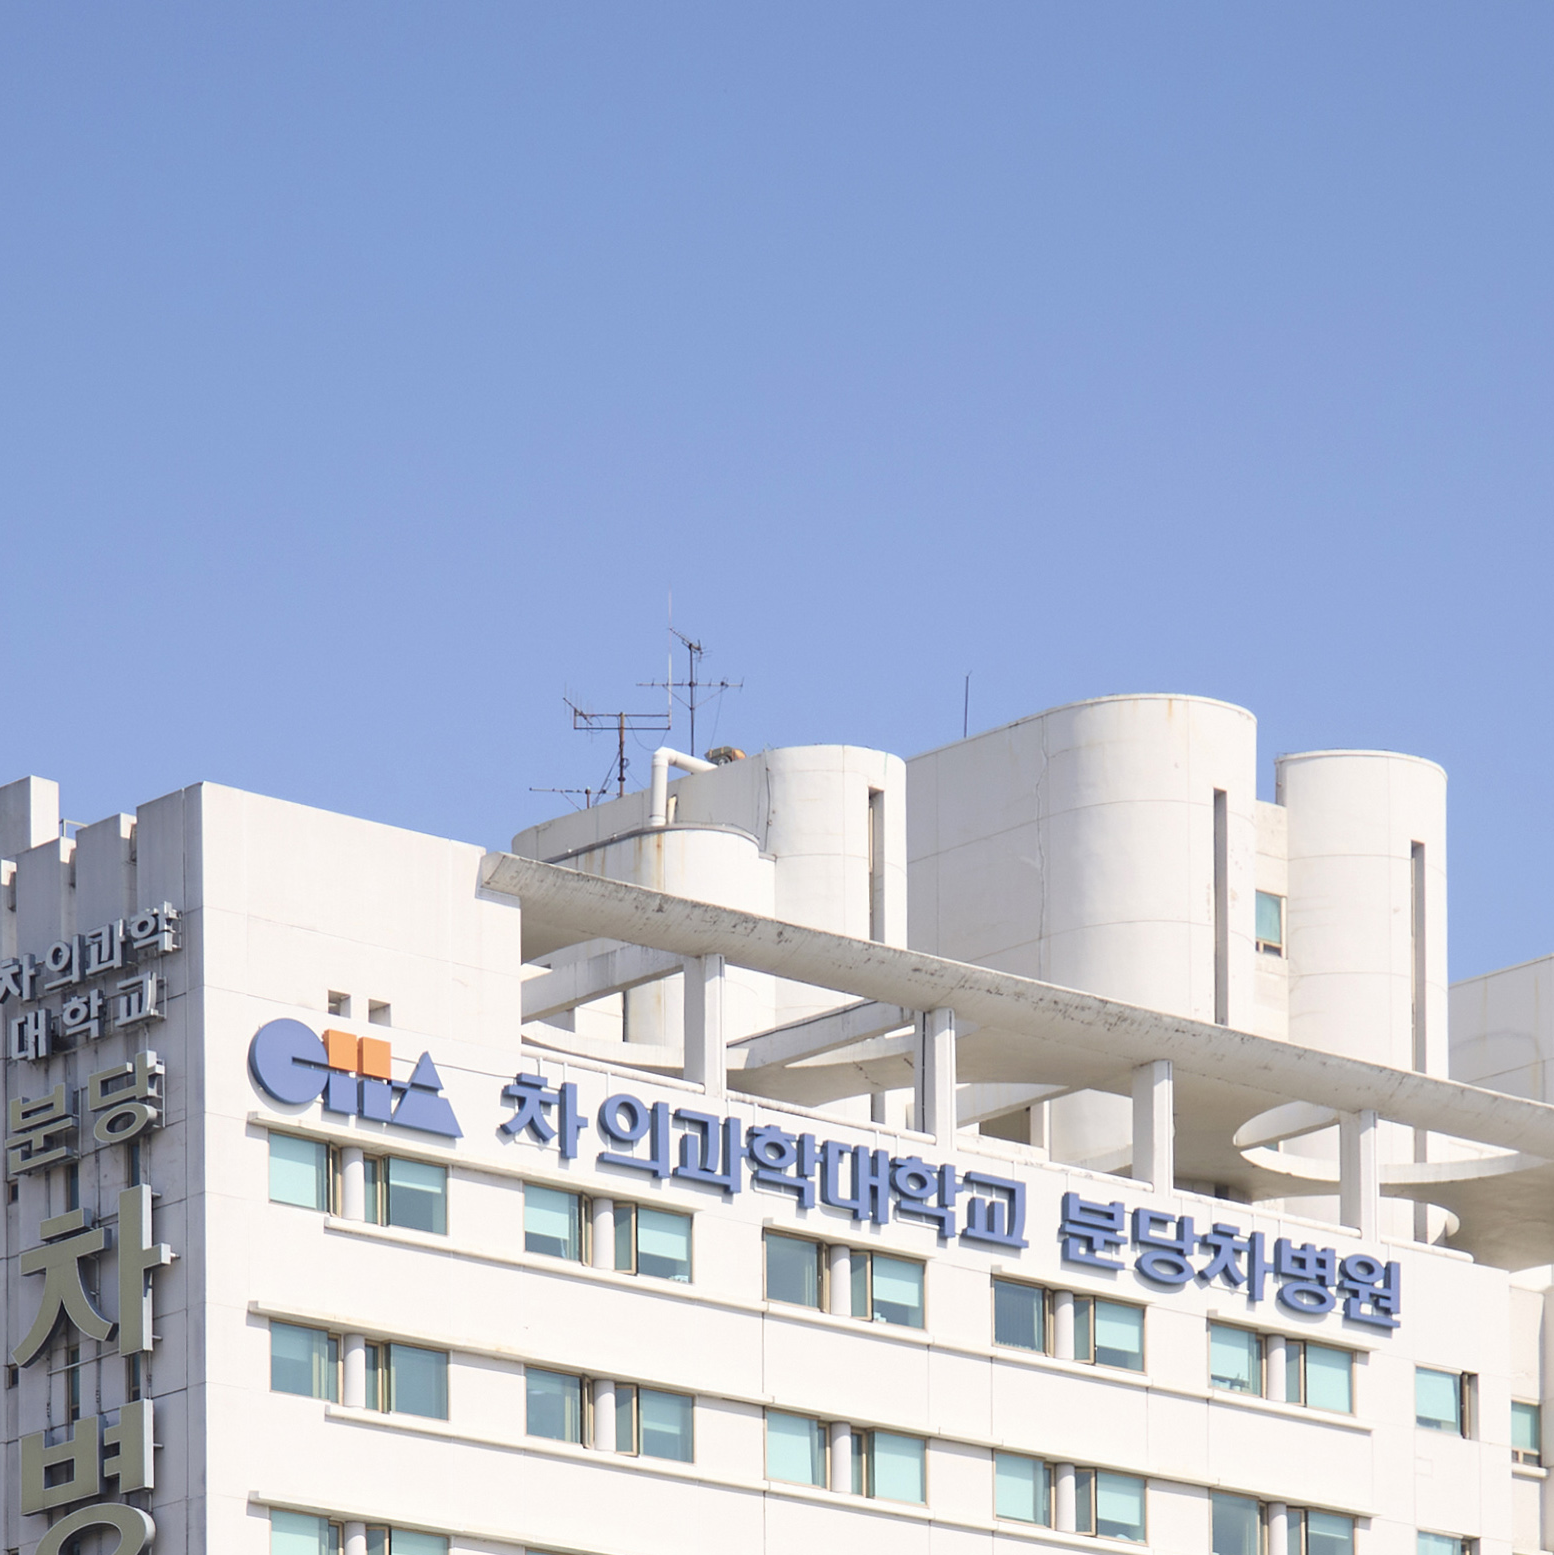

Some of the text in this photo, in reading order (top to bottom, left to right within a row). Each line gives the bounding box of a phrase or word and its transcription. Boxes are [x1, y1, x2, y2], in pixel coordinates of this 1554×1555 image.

[10, 971, 166, 1061] 대학교
[5, 1050, 165, 1175] 분당
[500, 1072, 1402, 1330] 차의과학대학교 분당차병원
